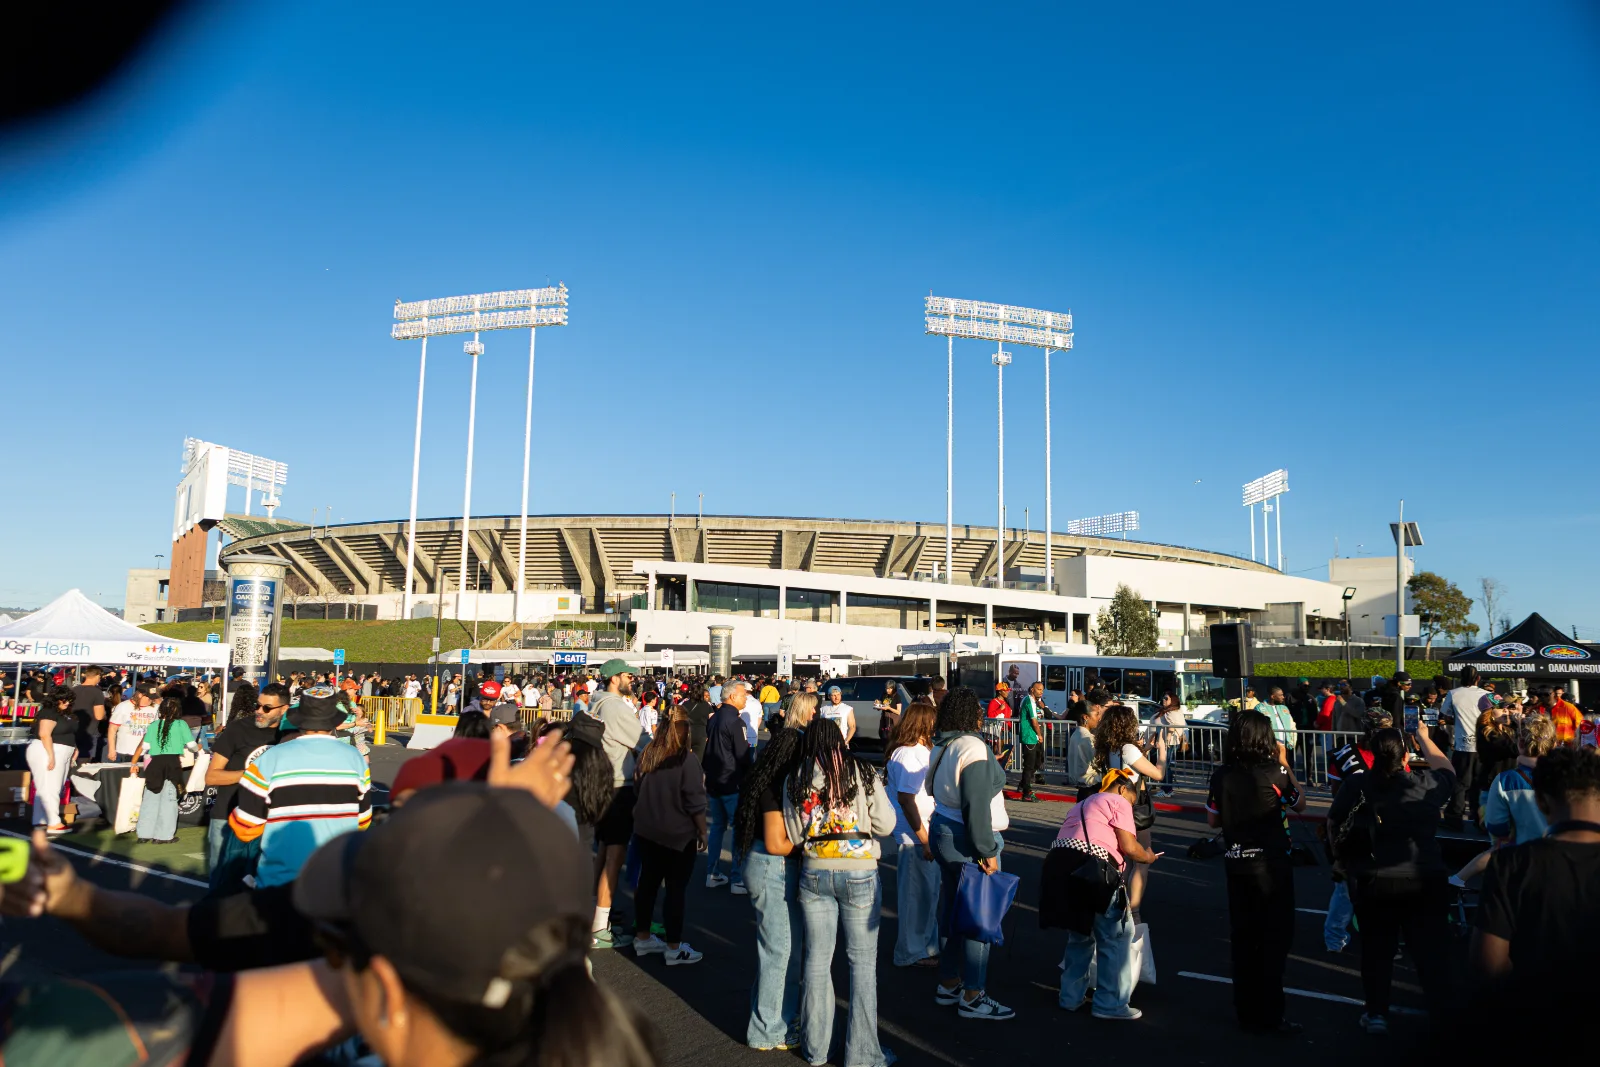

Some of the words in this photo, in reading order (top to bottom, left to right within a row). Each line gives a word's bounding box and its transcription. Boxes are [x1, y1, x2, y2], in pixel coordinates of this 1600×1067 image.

[554, 630, 583, 639] WELCOME
[585, 631, 593, 640] TO
[552, 638, 564, 647] THE
[34, 640, 91, 656] Health
[555, 654, 586, 663] D-GATE
[1448, 663, 1536, 672] OAKNDROOTSSC.COM
